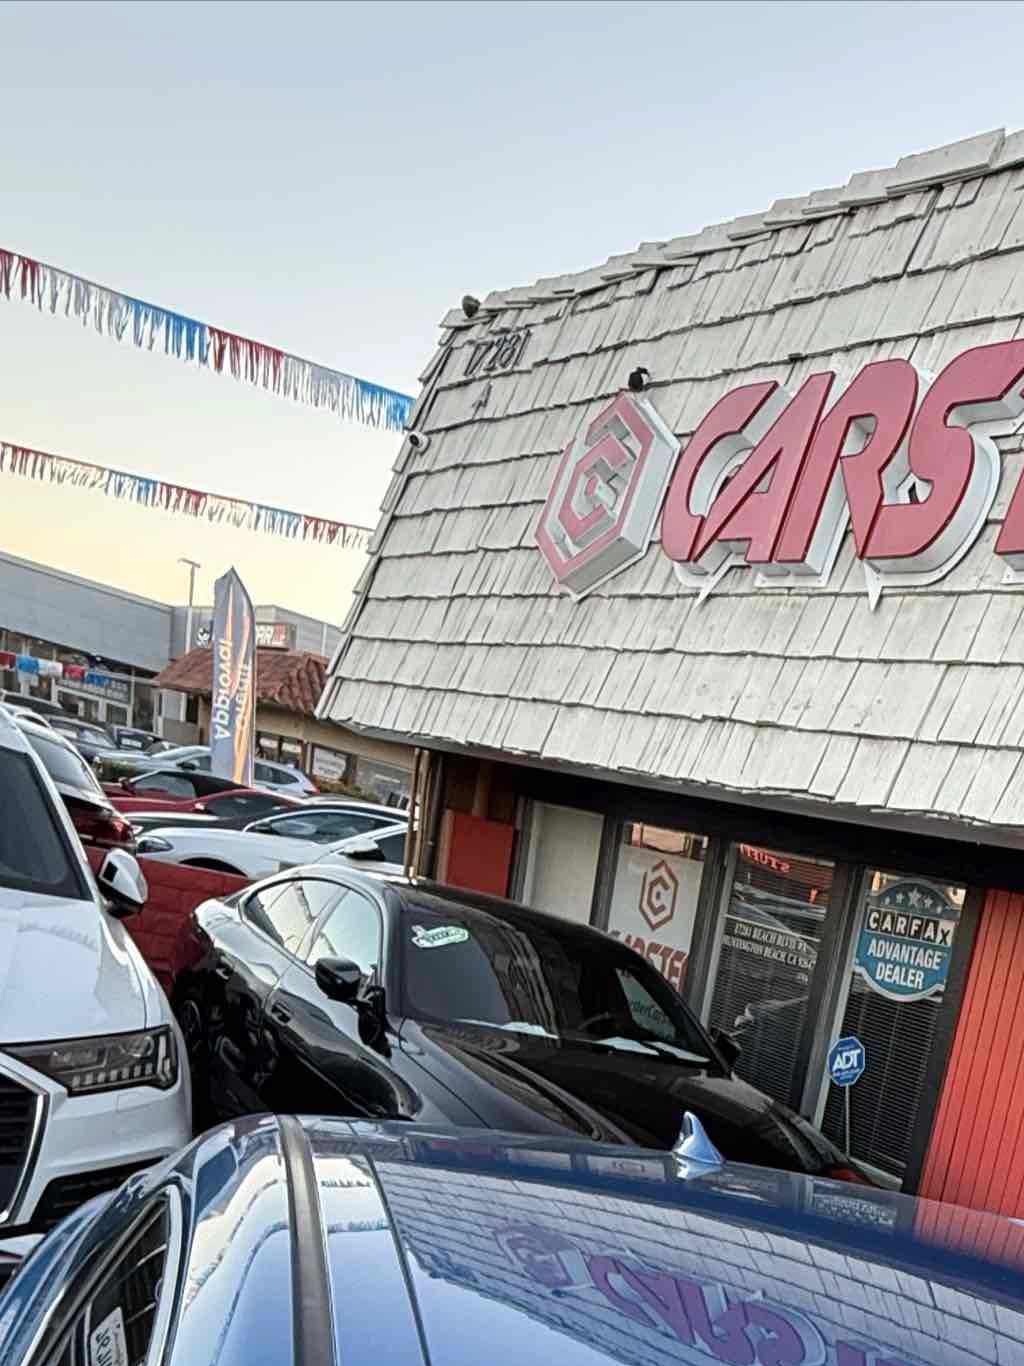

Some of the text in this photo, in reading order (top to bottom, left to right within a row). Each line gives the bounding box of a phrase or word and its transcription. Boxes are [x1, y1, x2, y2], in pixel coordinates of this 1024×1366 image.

[868, 911, 951, 945] CARFAX
[867, 937, 943, 971] ADVANTAGE
[875, 961, 925, 990] DEALER
[831, 1049, 861, 1072] ADT
